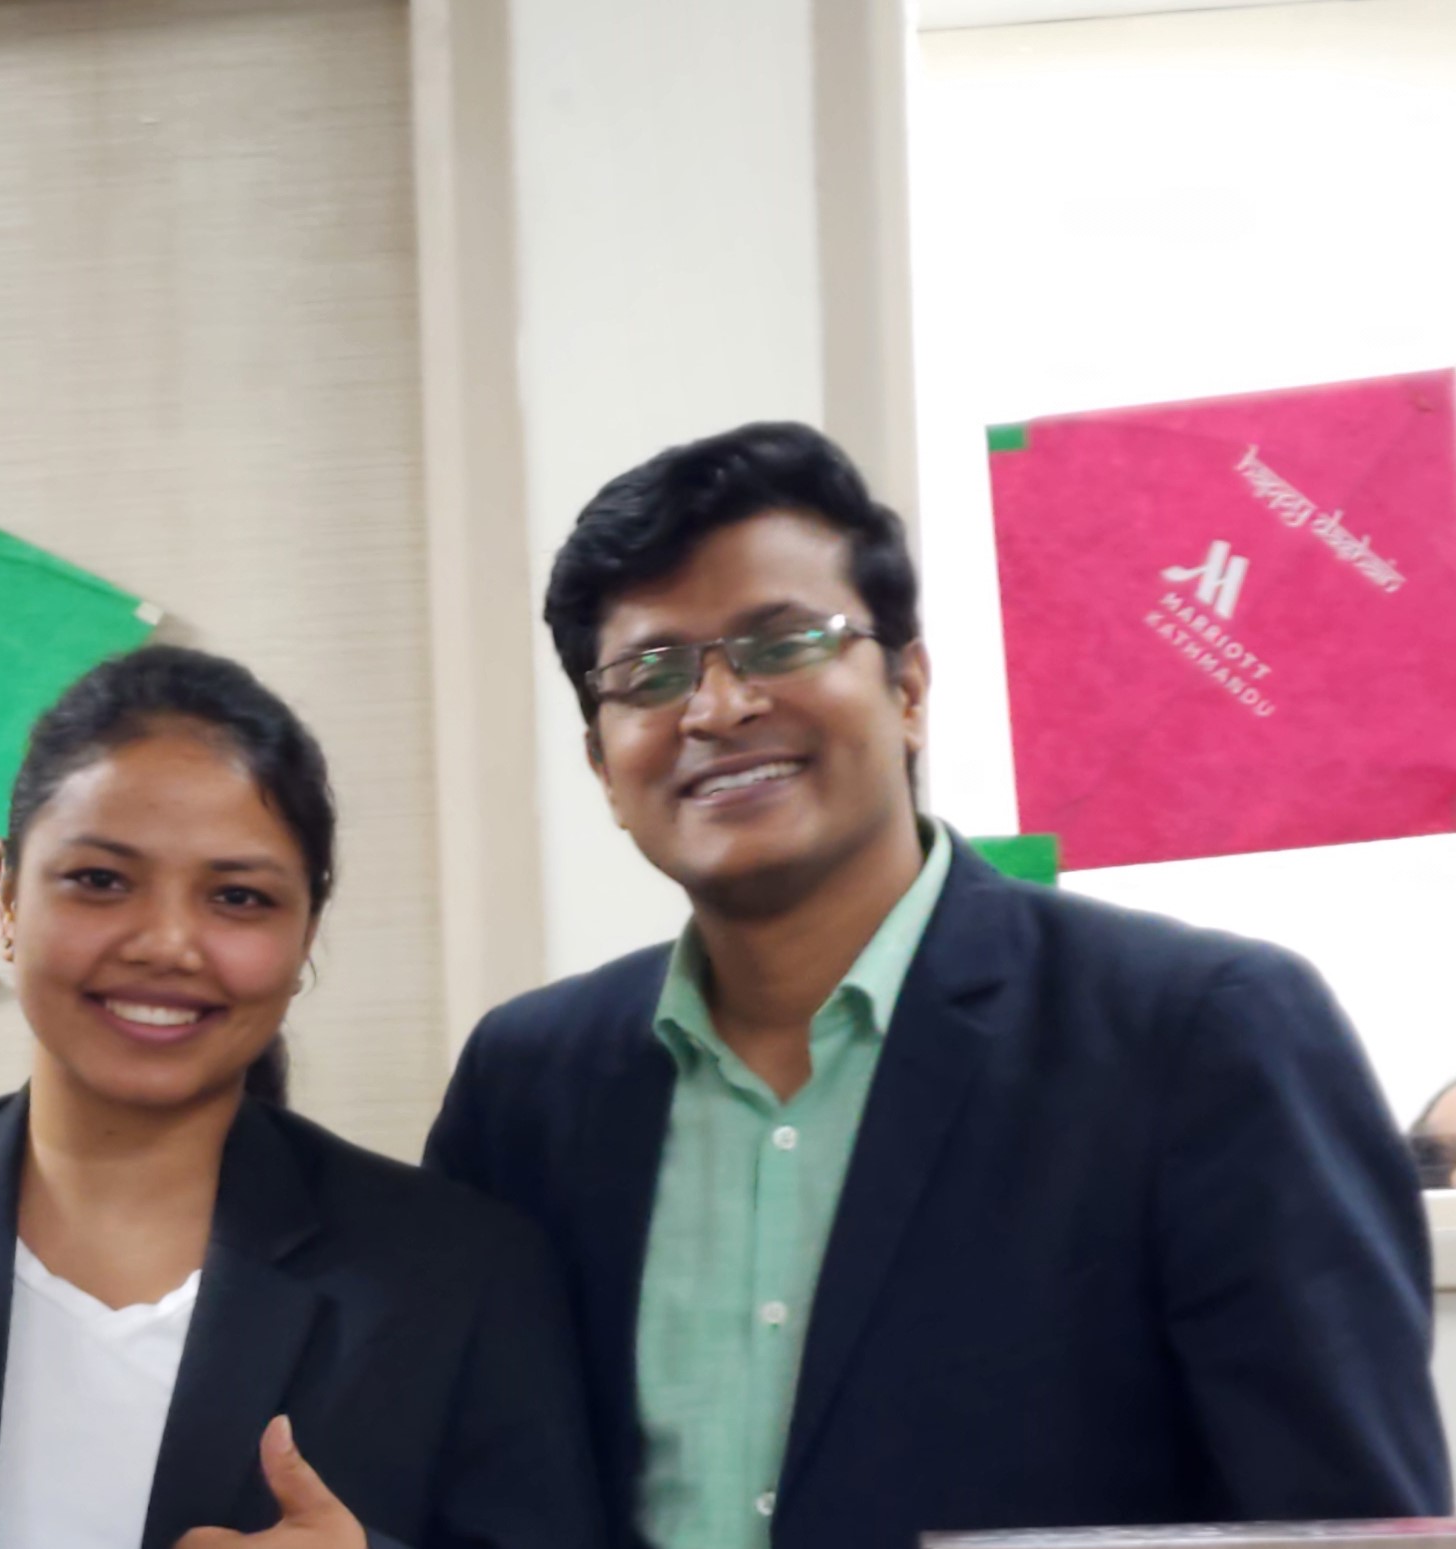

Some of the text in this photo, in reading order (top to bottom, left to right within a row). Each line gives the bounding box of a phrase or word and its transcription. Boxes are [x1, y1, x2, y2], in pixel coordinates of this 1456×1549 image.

[1234, 444, 1318, 528] happy
[1144, 610, 1276, 717] KATHMANDU
[1159, 592, 1272, 680] MARRIOTT
